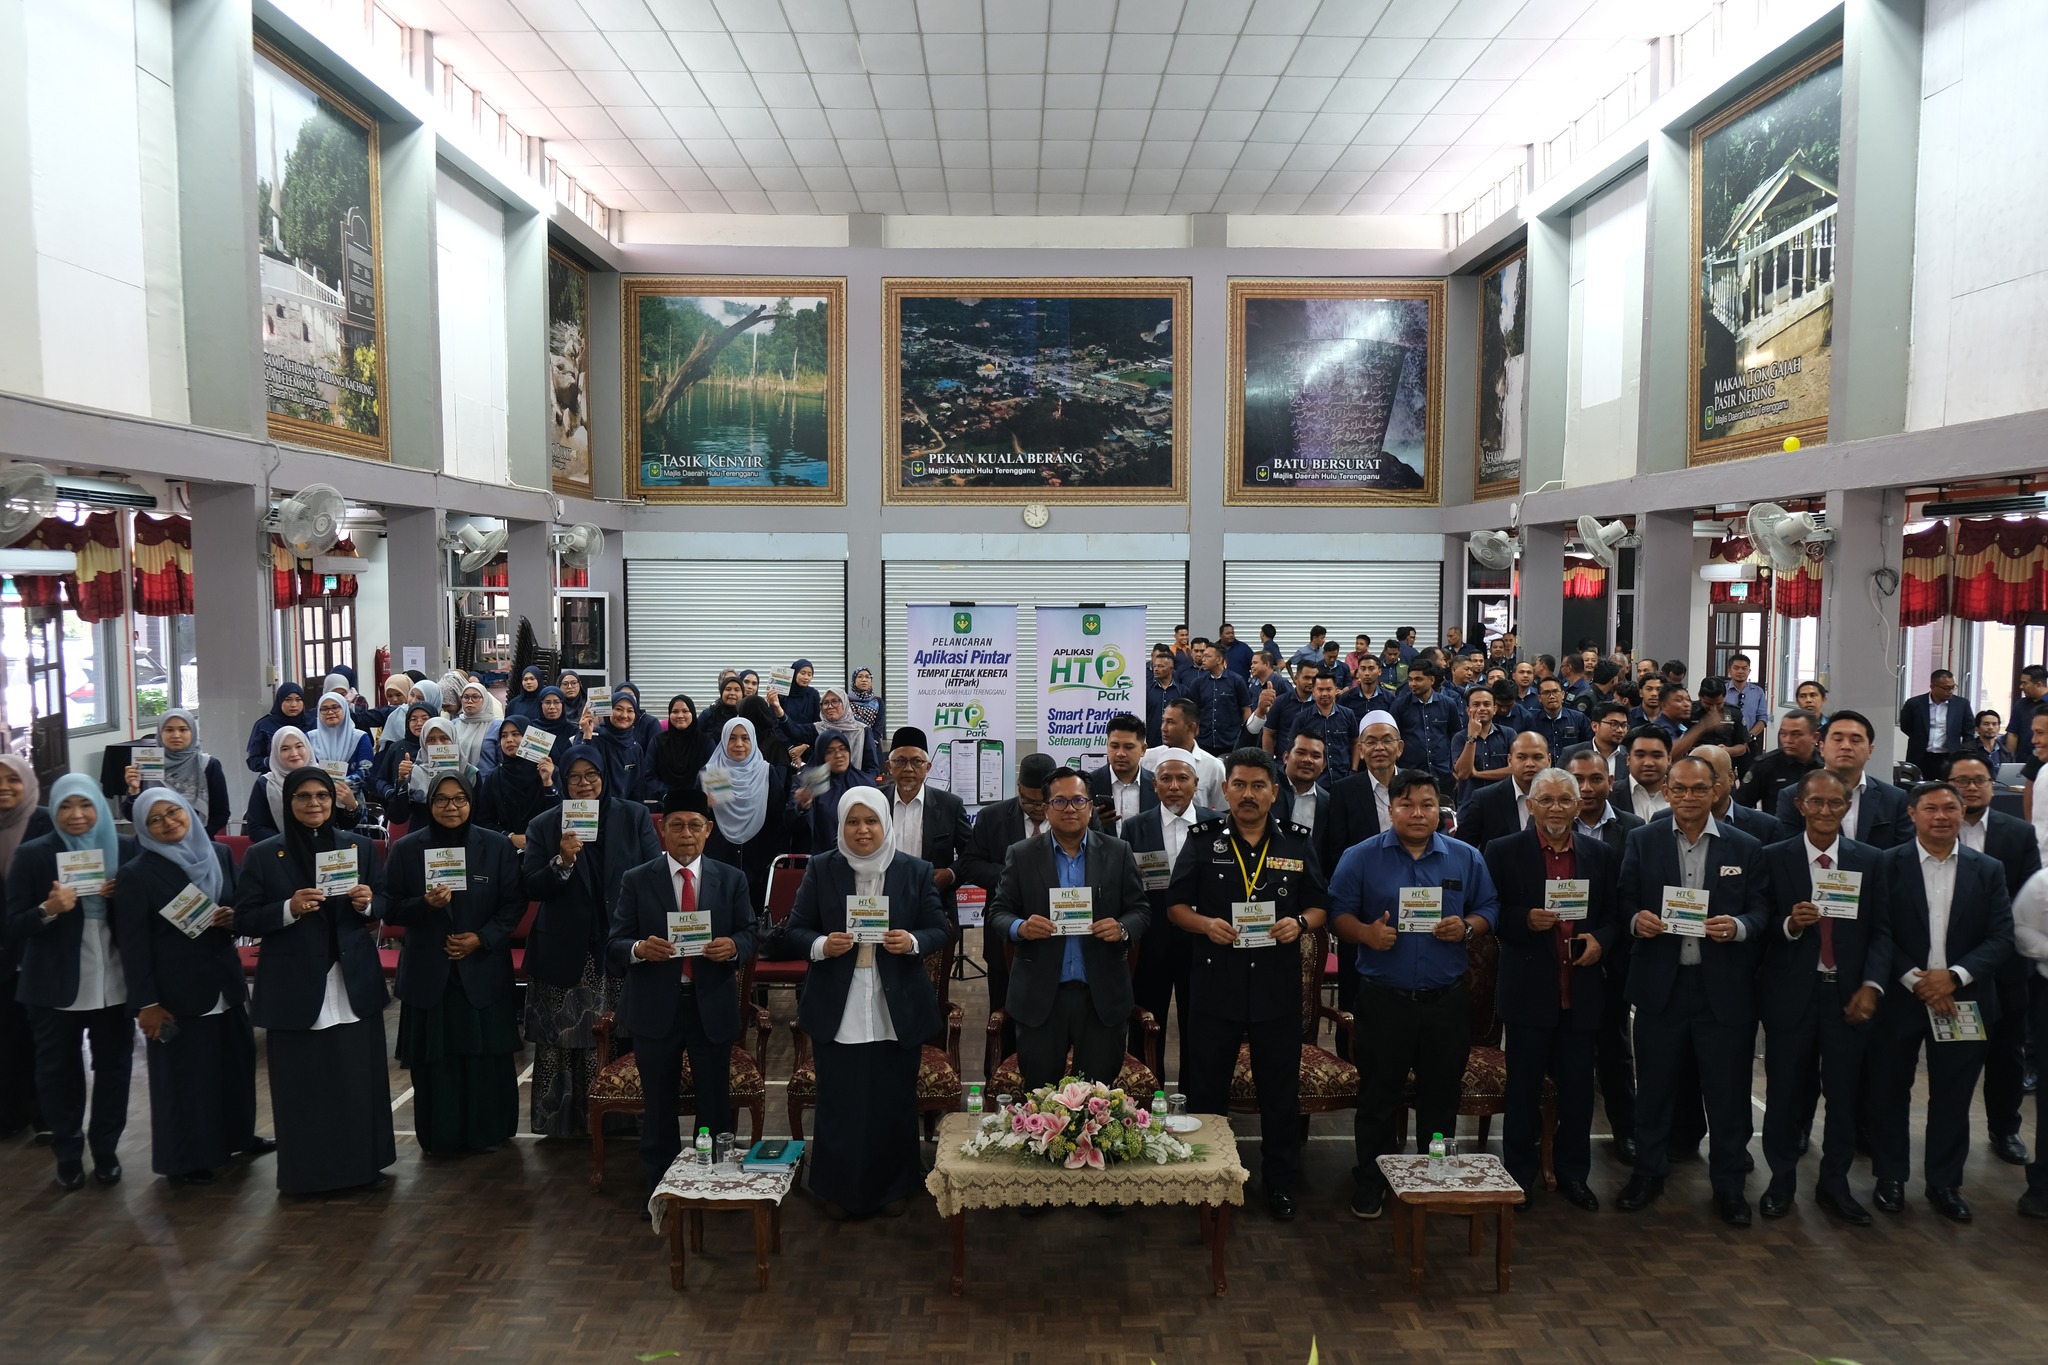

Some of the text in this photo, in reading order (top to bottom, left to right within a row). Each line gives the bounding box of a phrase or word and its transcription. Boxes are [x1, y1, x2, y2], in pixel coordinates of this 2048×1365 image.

[276, 370, 316, 392] TELEMONG
[280, 355, 317, 380] PAHLAWAN
[318, 367, 344, 387] PADANG
[345, 377, 374, 396] KACHONG
[1714, 357, 1802, 395] MAKAM TOK GAJAH
[269, 385, 288, 401] Daerah
[1714, 382, 1776, 412] PASIR NERING
[1714, 400, 1789, 426] Majlis Daerah Hulu Terengganu
[660, 453, 764, 468] TASIK KENYIR
[928, 453, 1083, 464] PEKAN KUALA BERANG
[1273, 459, 1382, 470] BATU BERSURAT
[663, 469, 759, 479] Majlis Daerah Hulu Terengganu
[928, 467, 949, 475] Majlis
[995, 467, 1036, 475] Terengganu
[1272, 472, 1380, 481] Majlis Daerah Hulu Terengganu
[932, 637, 993, 647] PELANCARAN
[1053, 648, 1094, 656] APLIKASI
[913, 649, 1012, 667] Aplikasi Pintar
[917, 669, 1008, 678] TEMPAT LETAK KERETA
[944, 678, 980, 688] (HTPark)
[918, 688, 1007, 696] MAJLIS DAERAH HULU TERENGGANU
[1097, 690, 1130, 701] Park
[1047, 708, 1083, 721] Smart
[1047, 721, 1084, 734] Smart
[966, 730, 987, 738] Park
[1048, 735, 1092, 748] Setenang
